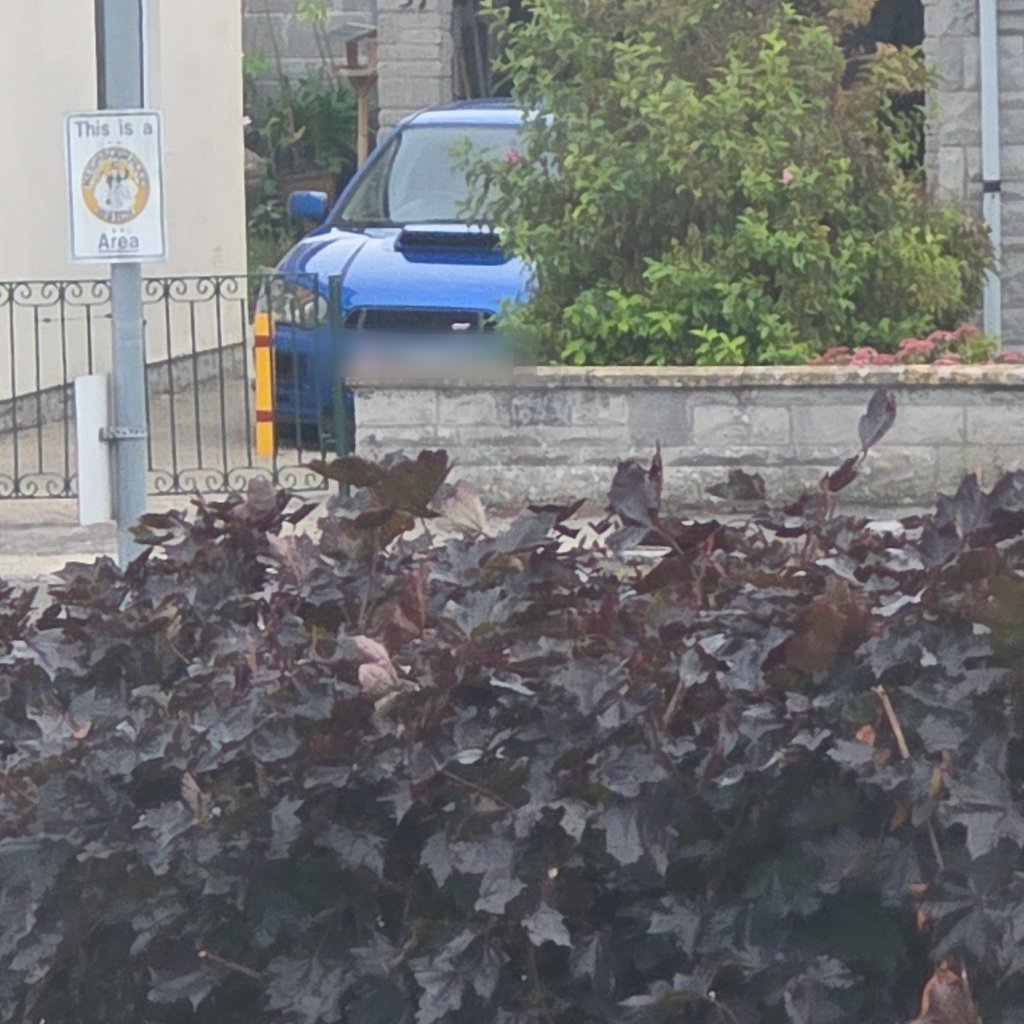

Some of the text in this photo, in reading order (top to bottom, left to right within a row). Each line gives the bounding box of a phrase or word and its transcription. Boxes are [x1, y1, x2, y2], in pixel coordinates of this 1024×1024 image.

[74, 119, 153, 137] This is a
[98, 233, 139, 249] Area
